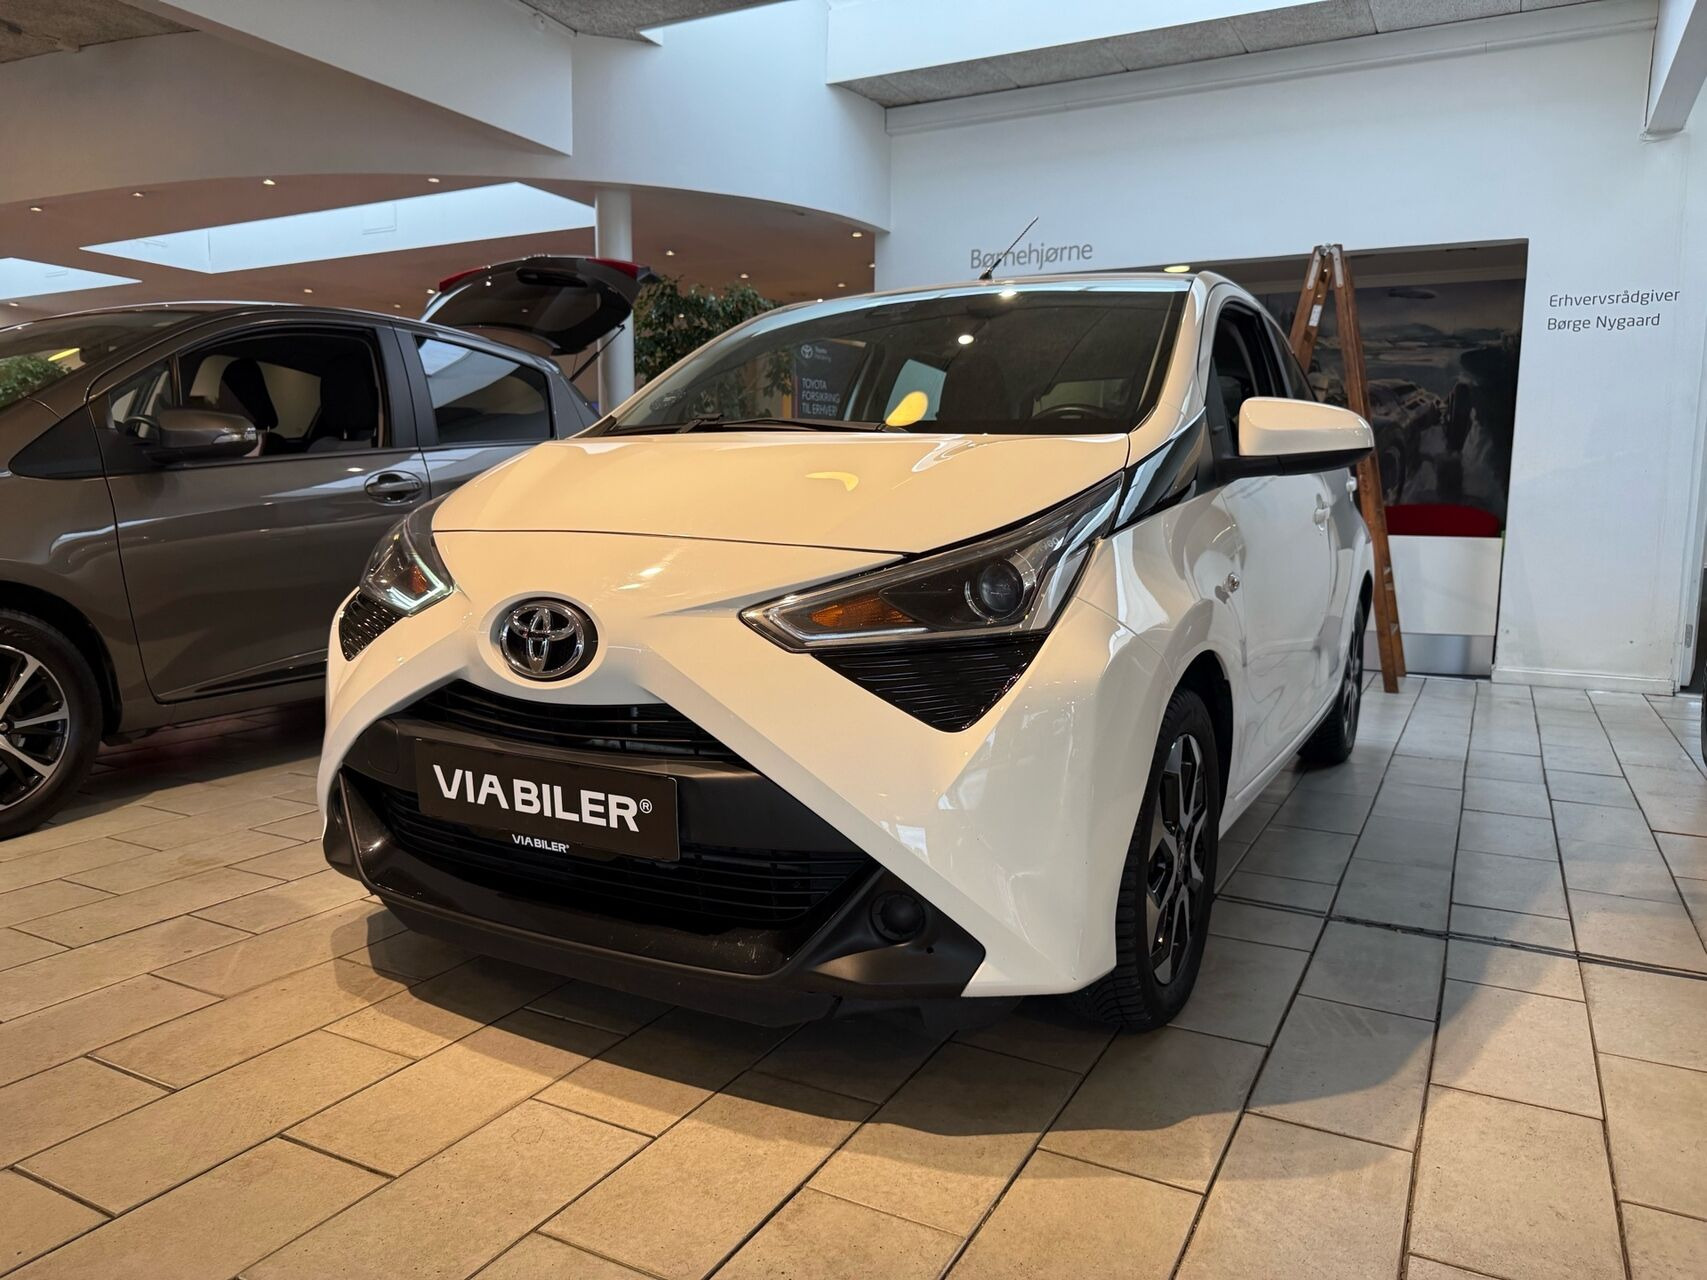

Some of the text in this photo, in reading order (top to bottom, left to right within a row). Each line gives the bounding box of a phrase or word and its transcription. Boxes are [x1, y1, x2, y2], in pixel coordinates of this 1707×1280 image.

[970, 242, 1093, 271] Børnehjørne
[1549, 290, 1680, 307] Erhvervsrådgiver
[1547, 313, 1661, 332] Børge Nygaard
[802, 377, 827, 391] TOYOTA
[433, 764, 509, 809] VIA
[512, 834, 534, 847] VIA
